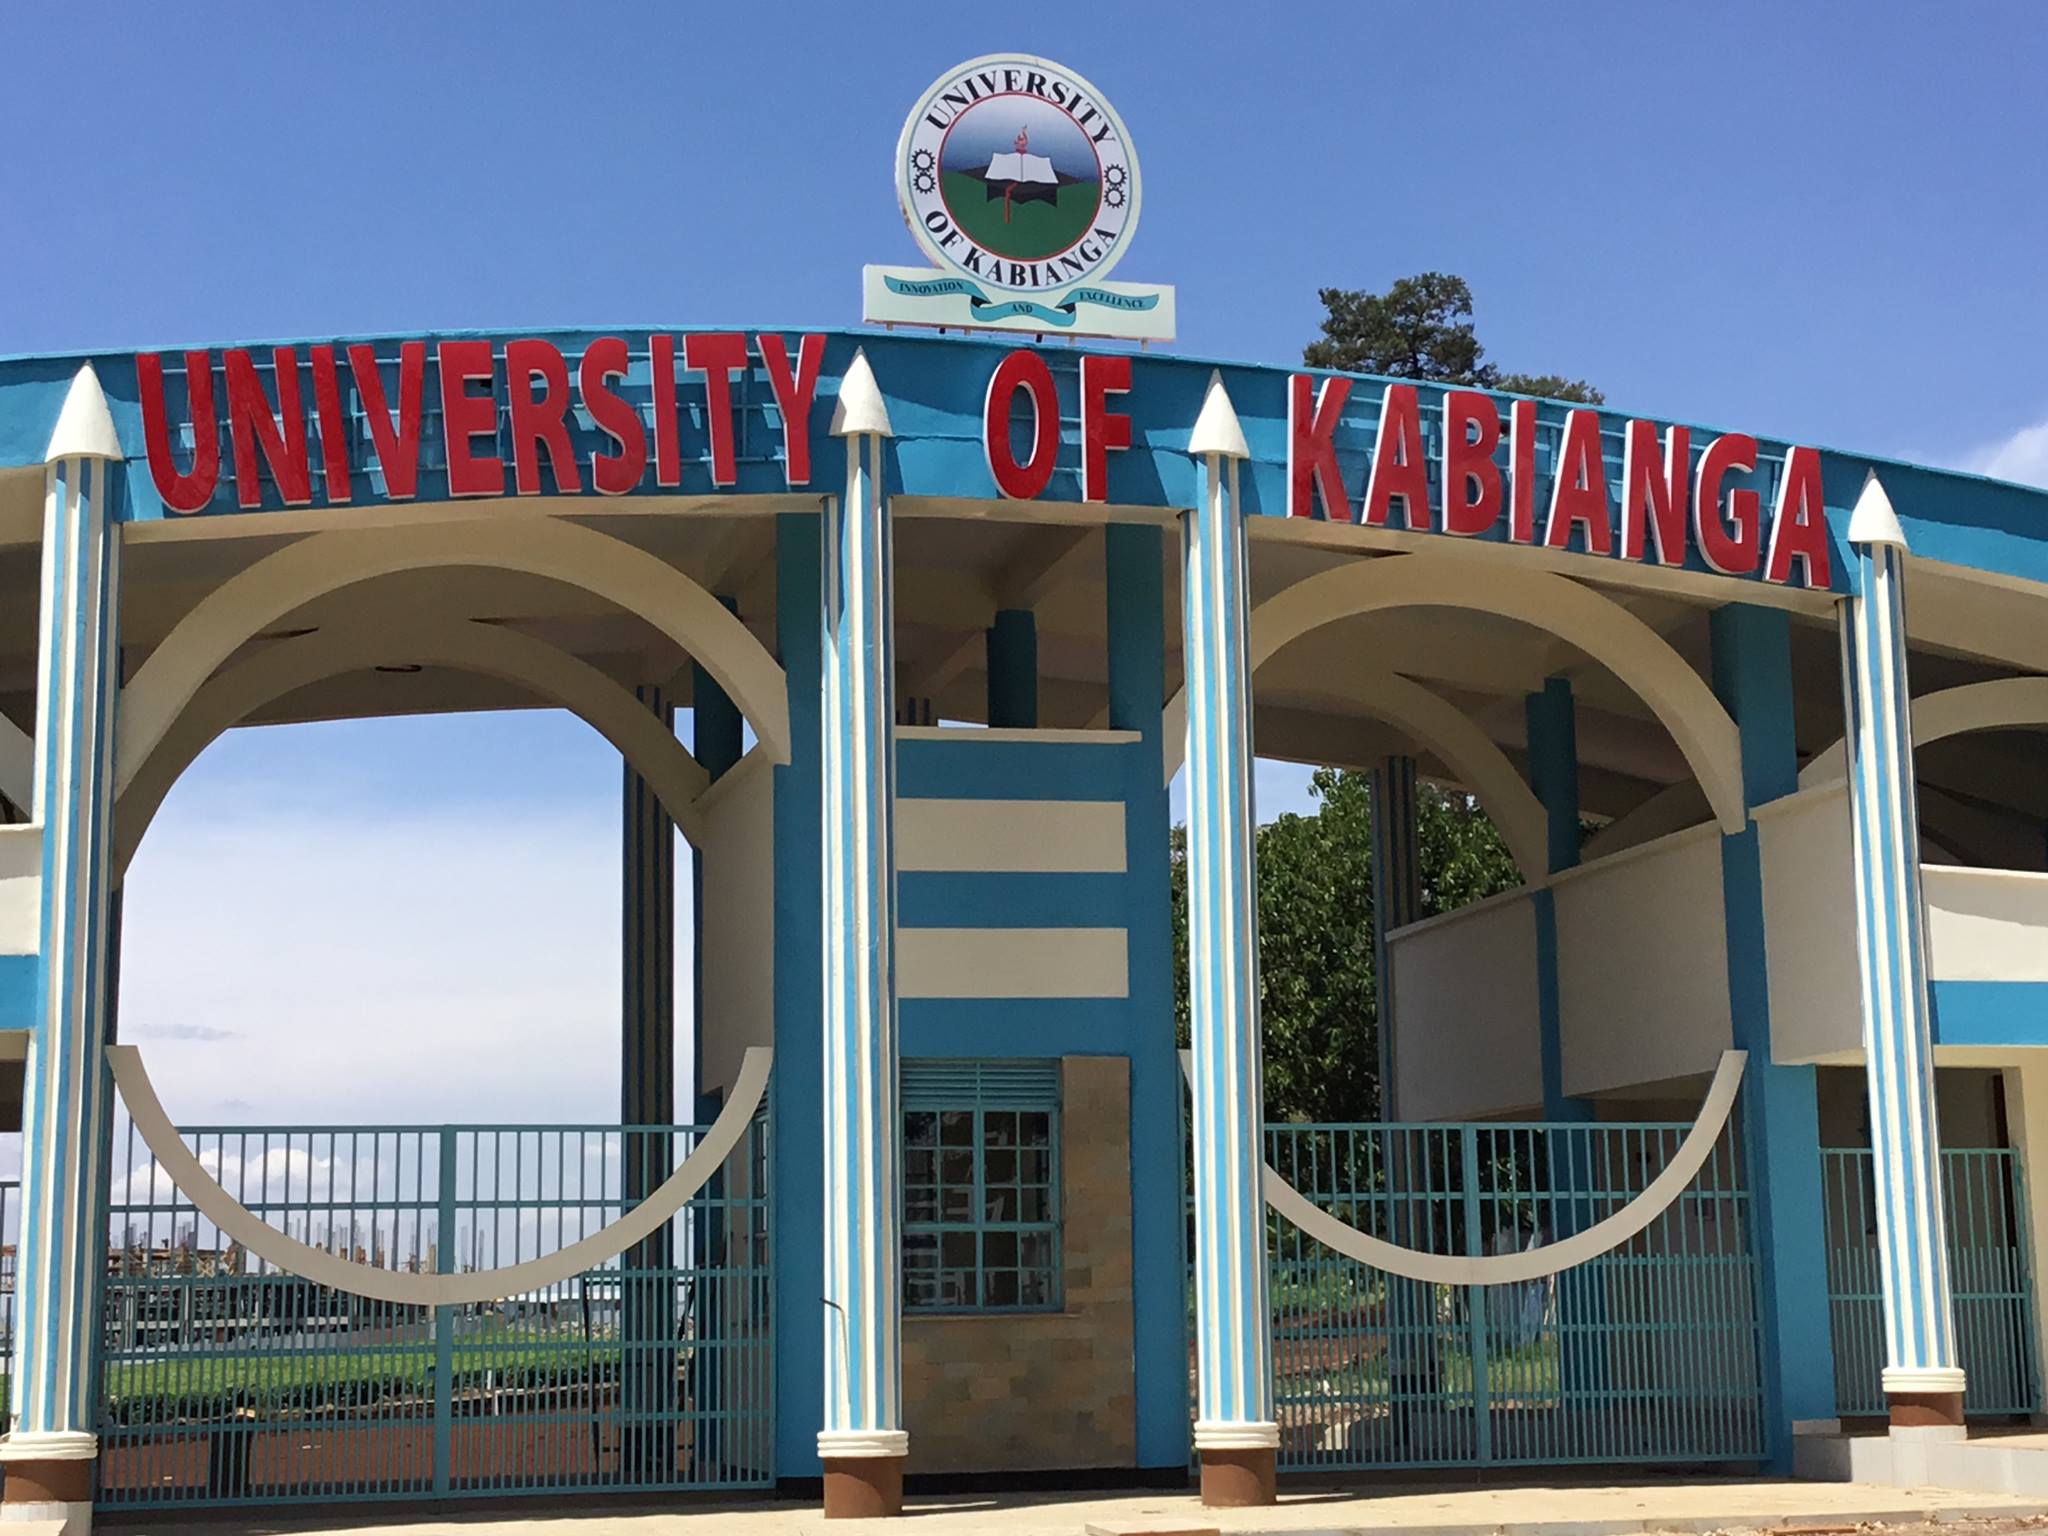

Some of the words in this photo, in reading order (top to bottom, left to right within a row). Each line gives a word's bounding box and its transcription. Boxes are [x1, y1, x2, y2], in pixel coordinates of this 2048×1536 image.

[925, 69, 1116, 145] UNIVERSITY
[925, 210, 965, 249] OF
[963, 227, 1117, 287] KABIANGA
[899, 281, 964, 294] INNOVATION
[1011, 303, 1034, 314] AND
[1079, 291, 1145, 308] EXCELLENCE
[135, 333, 827, 513] UNIVERSITY
[983, 349, 1133, 503] OF
[1286, 373, 1831, 590] KABIANGA
